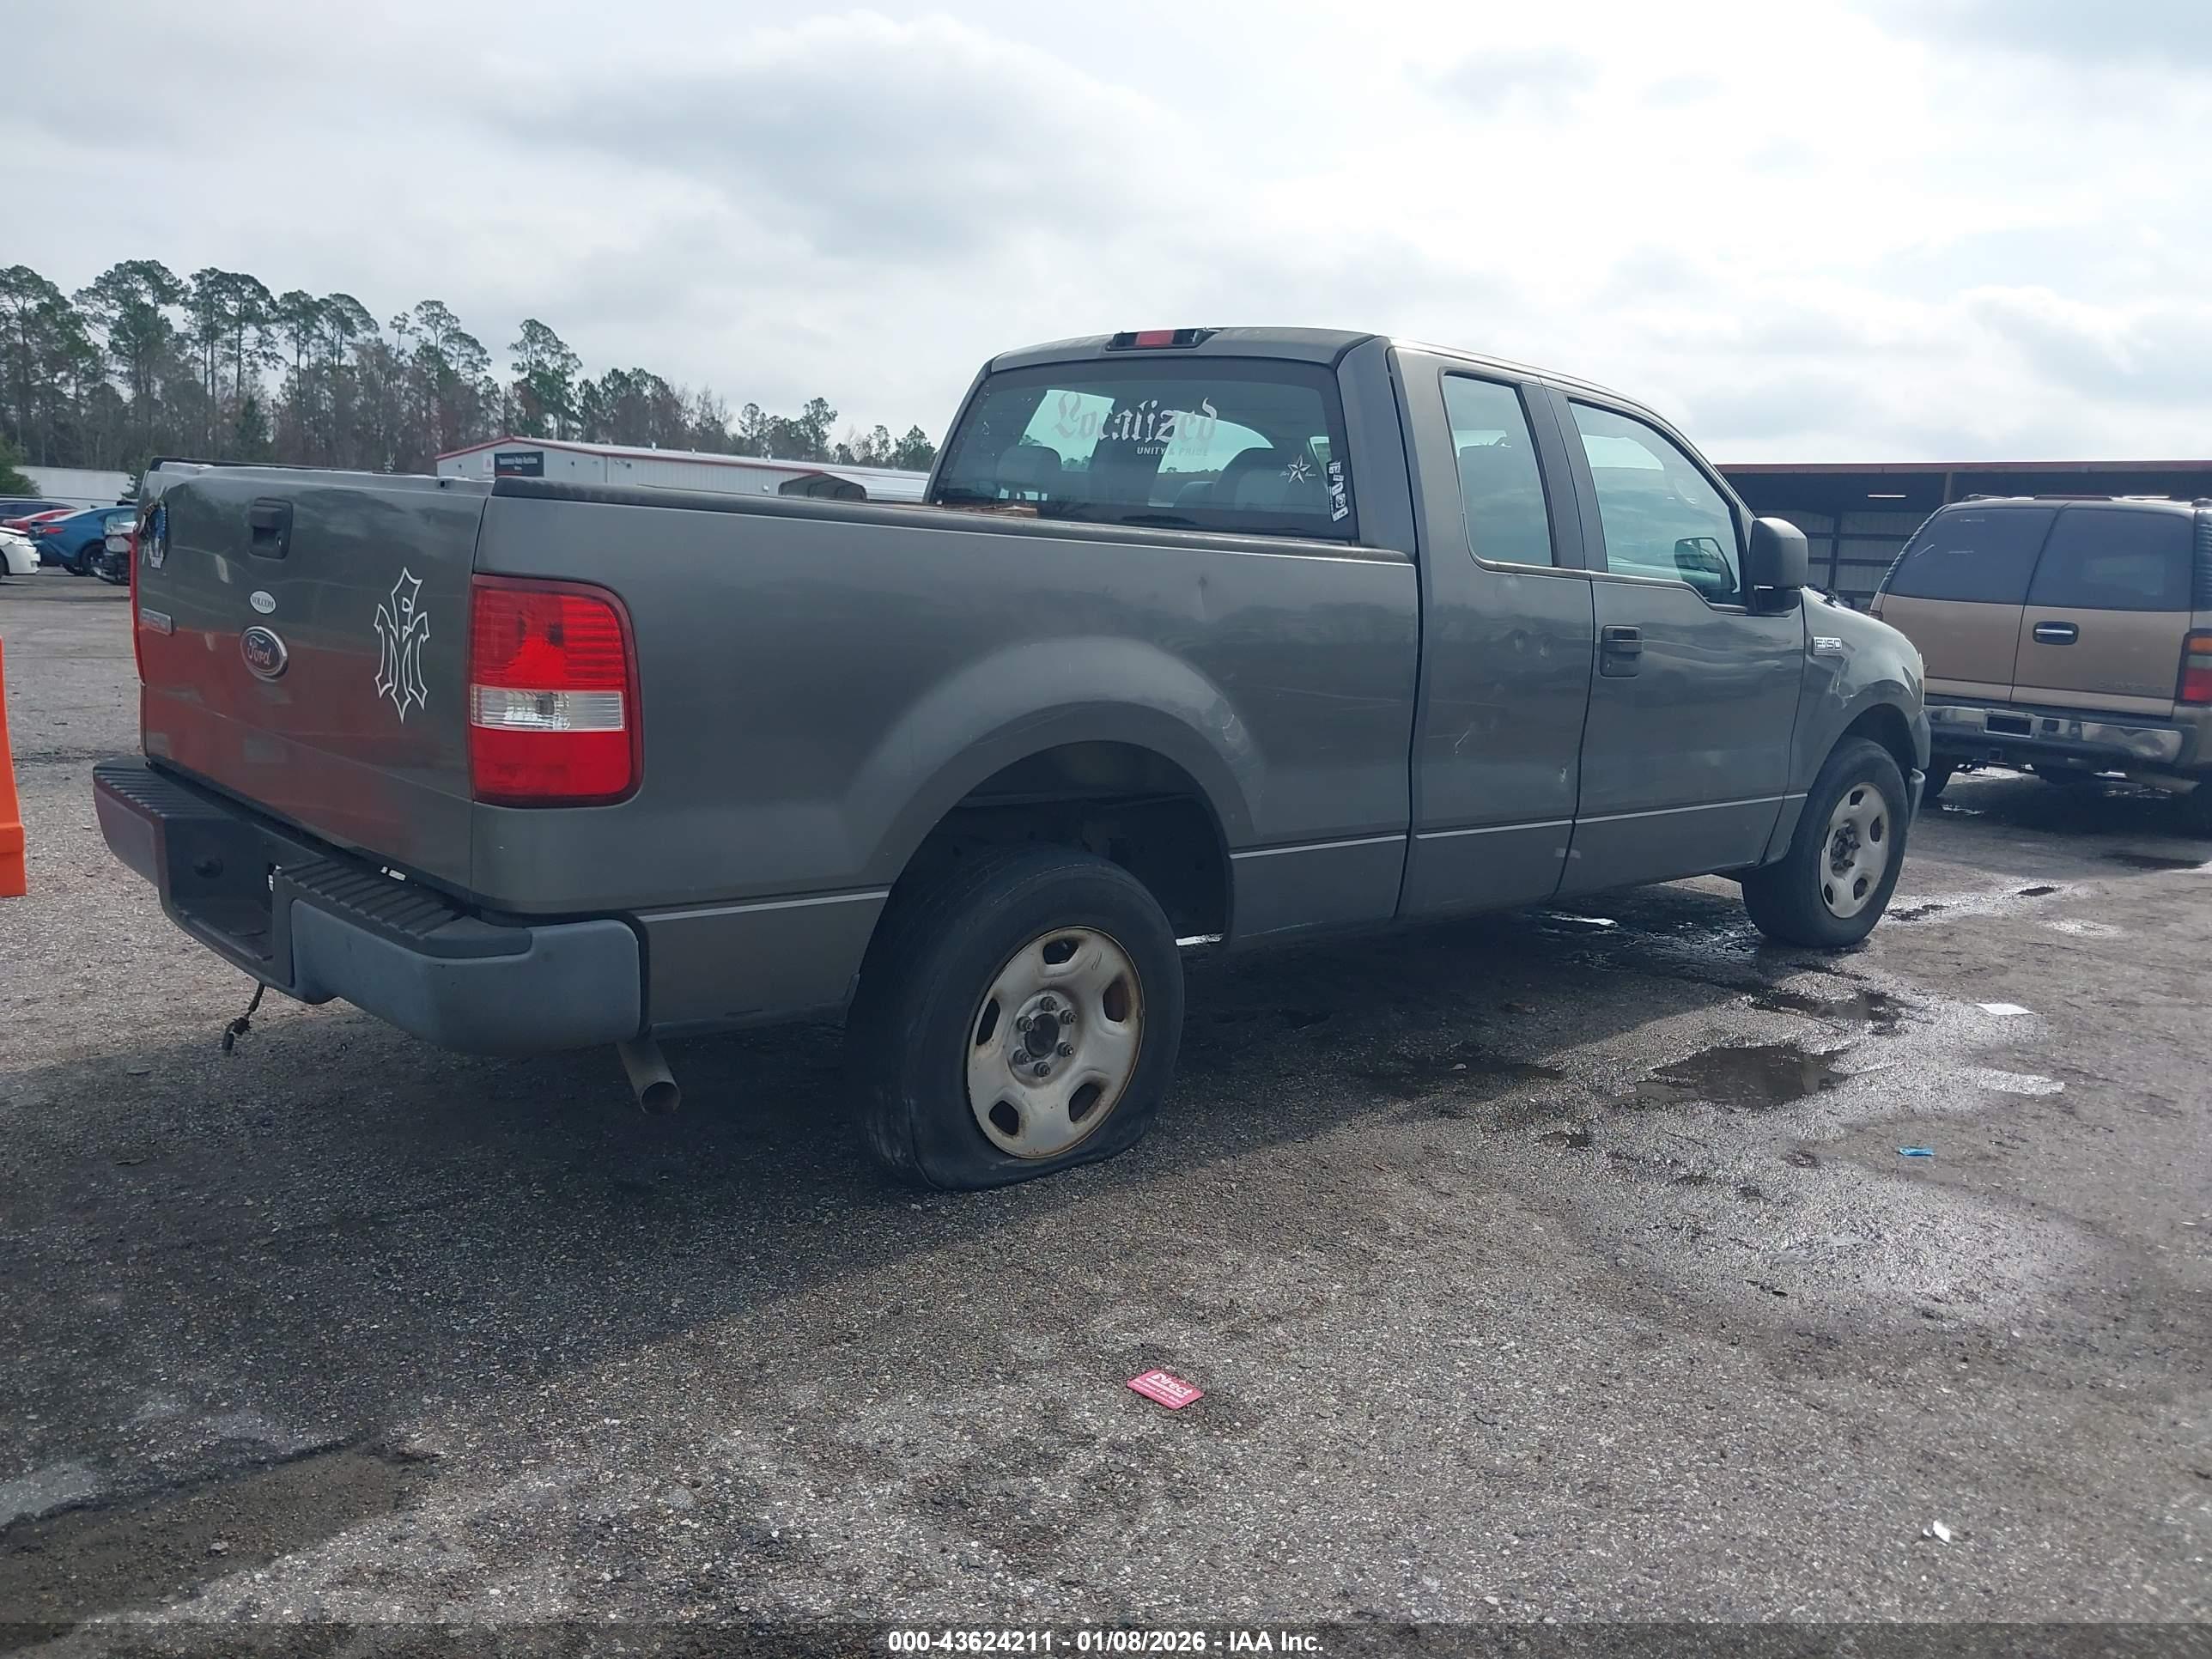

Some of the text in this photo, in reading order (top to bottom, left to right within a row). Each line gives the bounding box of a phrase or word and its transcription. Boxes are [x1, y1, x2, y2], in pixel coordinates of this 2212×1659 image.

[1054, 392, 1218, 442] Localized
[1137, 446, 1166, 456] UNITY
[248, 635, 271, 665] Ford
[1151, 1372, 1194, 1396] Direct
